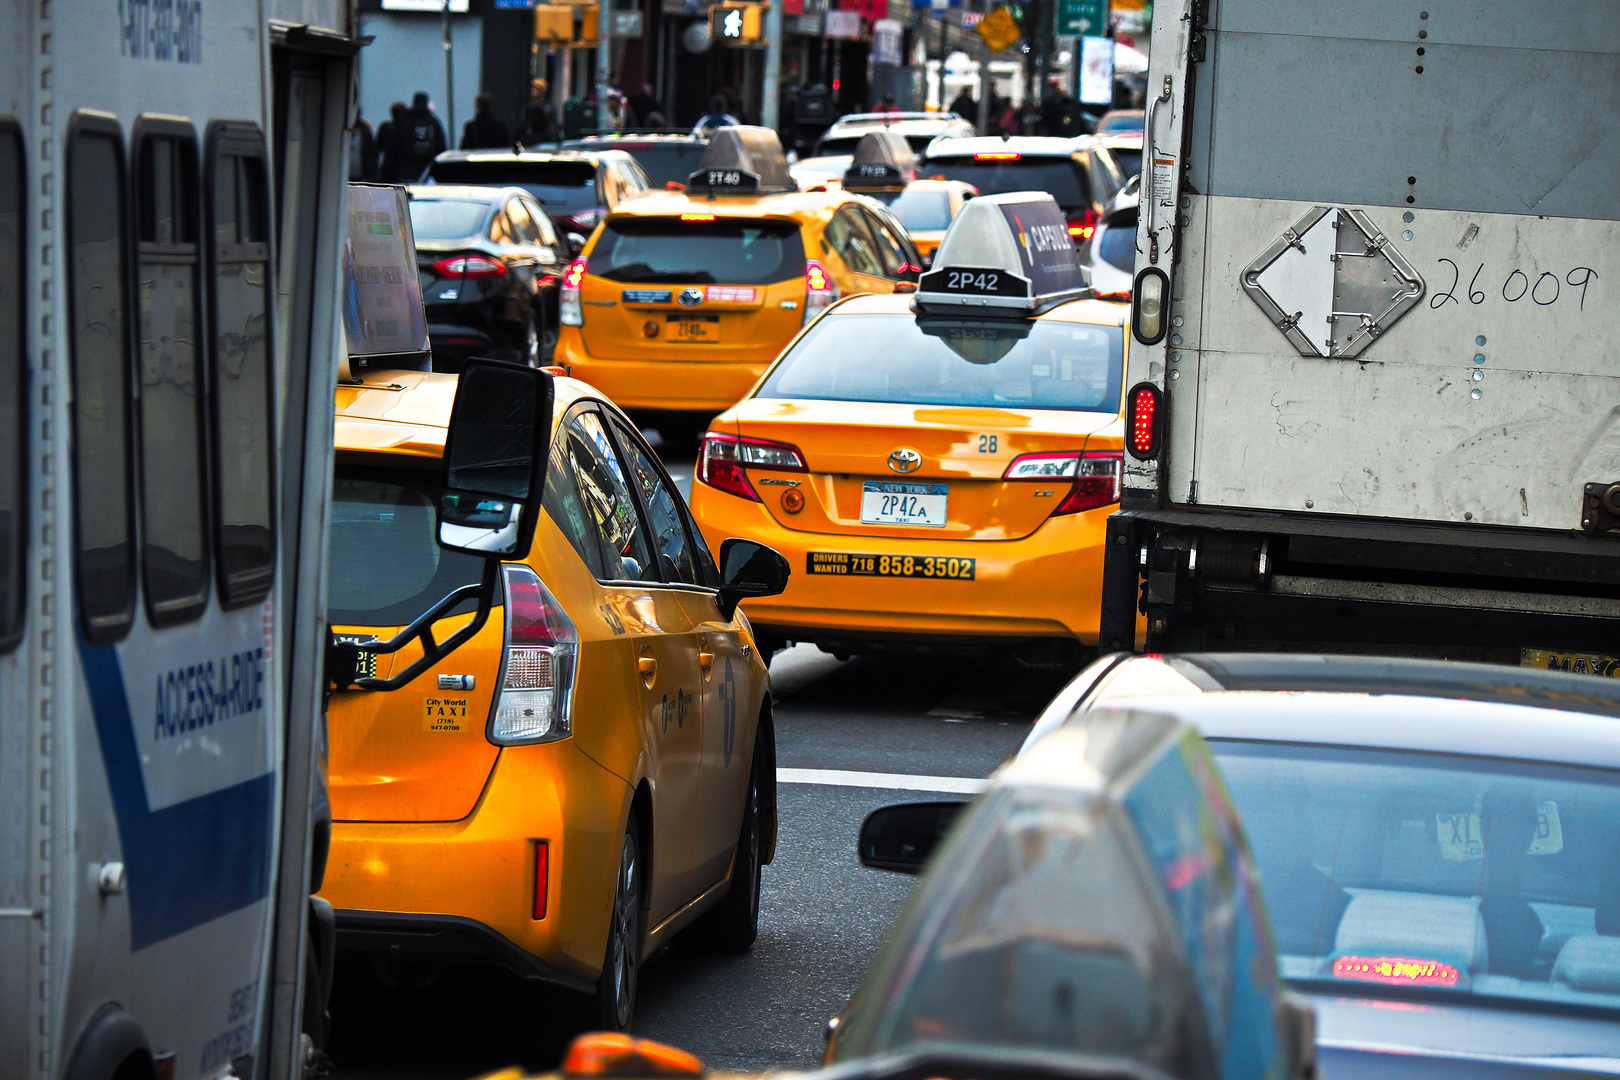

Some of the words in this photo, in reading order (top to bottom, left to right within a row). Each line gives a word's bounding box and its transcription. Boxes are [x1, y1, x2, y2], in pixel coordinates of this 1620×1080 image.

[707, 171, 740, 186] 2T40
[1031, 224, 1072, 253] CAPSULE
[947, 271, 999, 291] 2P42
[979, 434, 999, 454] 28
[884, 483, 905, 493] NEW
[906, 485, 928, 495] YORK
[813, 552, 848, 563] DRIVERS
[813, 564, 847, 574] WANTED
[851, 557, 875, 571] 718
[879, 555, 972, 578] 858-3502
[154, 647, 263, 741] ACCESS-A-RIDE
[426, 698, 442, 707] City
[426, 706, 466, 717] TAXI
